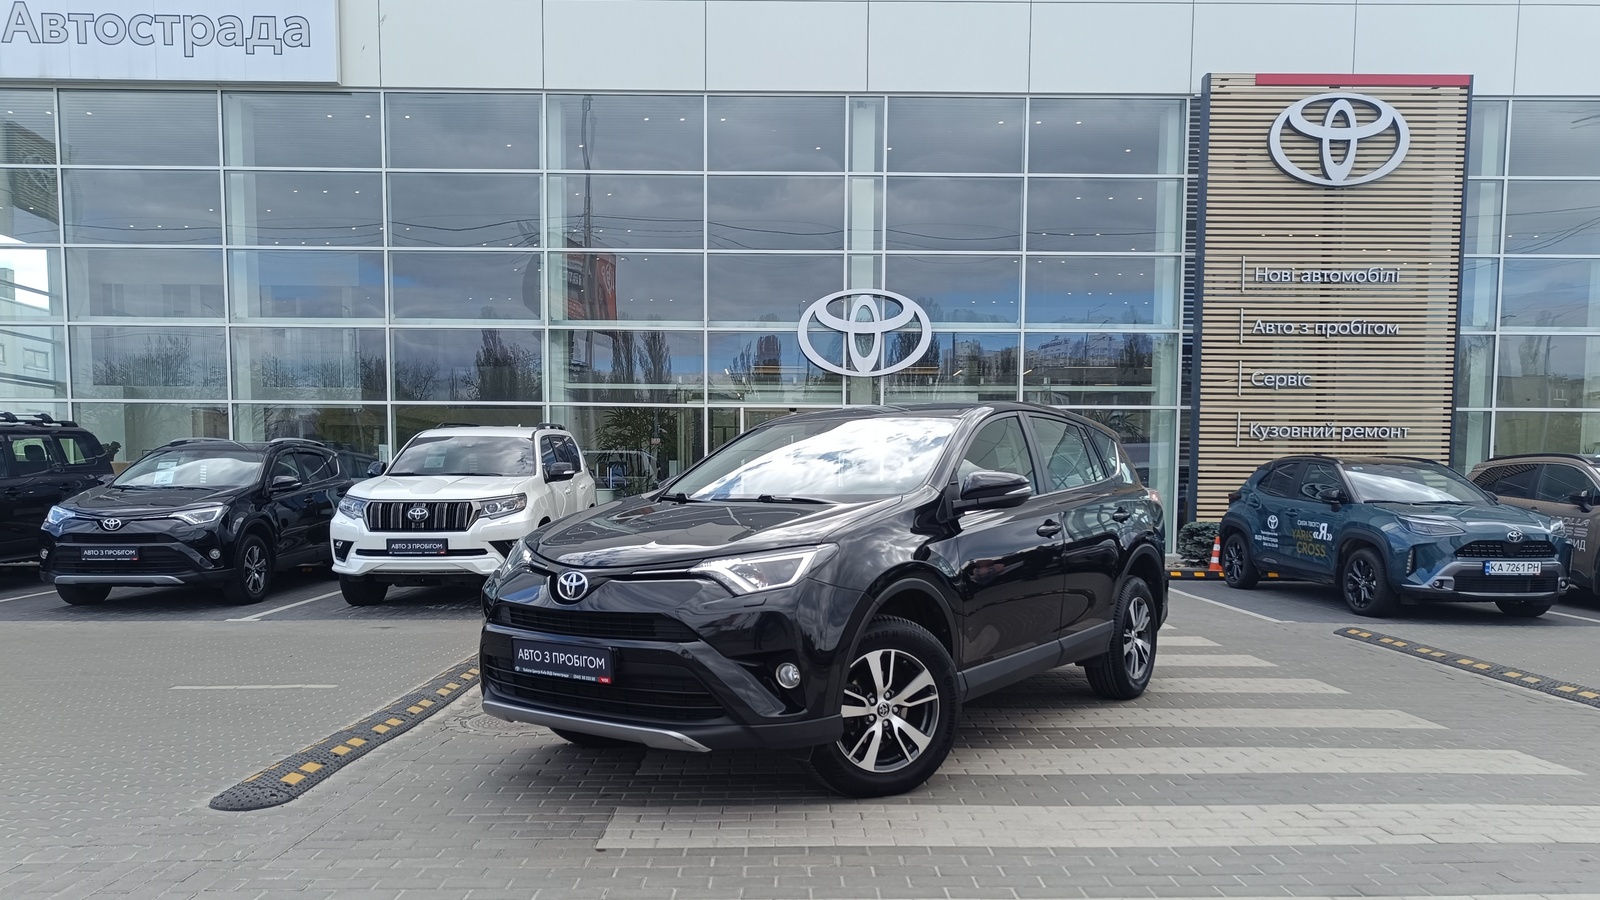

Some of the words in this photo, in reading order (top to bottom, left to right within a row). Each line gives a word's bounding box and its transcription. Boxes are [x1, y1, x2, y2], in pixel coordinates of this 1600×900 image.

[1, 1, 311, 58] Автострада
[1254, 266, 1296, 283] Нові
[1300, 266, 1401, 284] автомобілі
[1252, 319, 1295, 335] Авто
[1299, 322, 1309, 335] з
[1314, 319, 1400, 339] пробігом
[1251, 371, 1312, 391] Сервіс
[1249, 422, 1337, 442] Кузовний
[1341, 426, 1411, 442] ремонт
[1291, 528, 1313, 542] YARIS
[1296, 541, 1326, 558] CROSS
[1505, 563, 1526, 572] 7261
[518, 648, 542, 662] АВТО
[544, 651, 550, 663] З
[552, 652, 605, 670] ПРОБІГОМ
